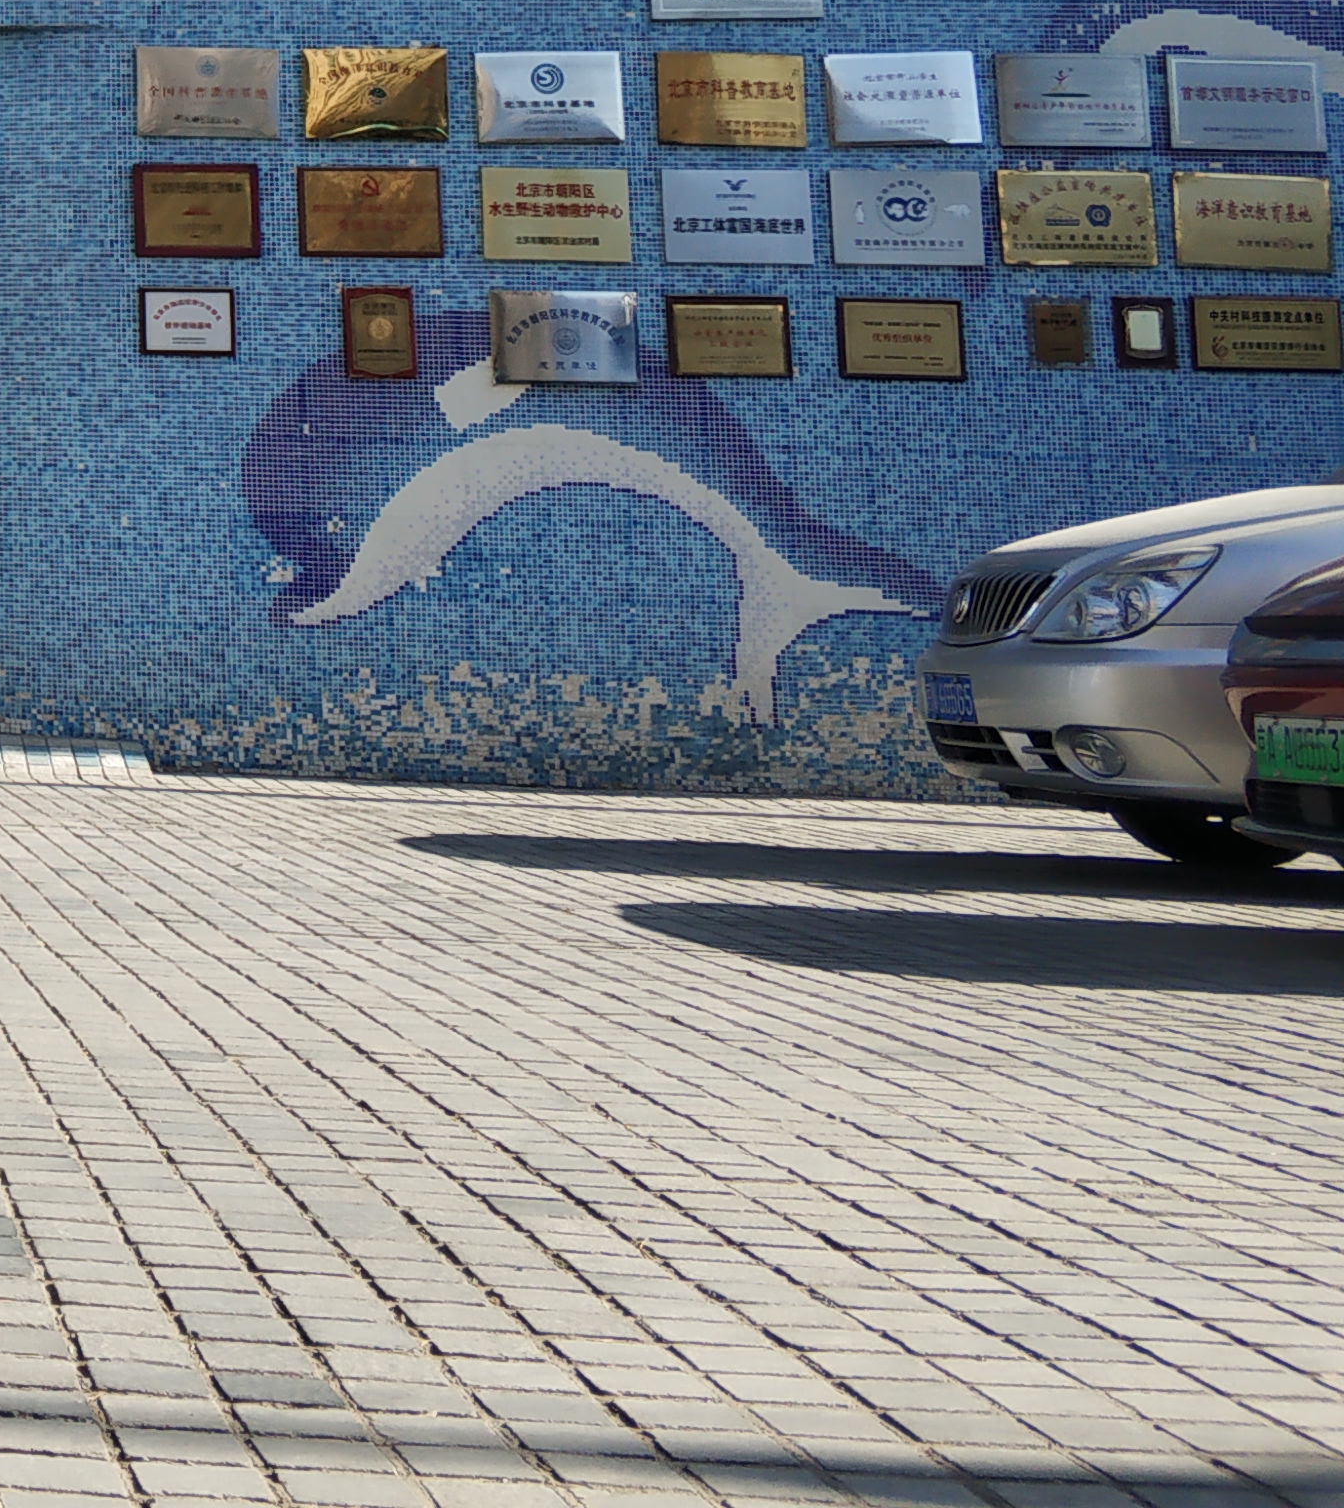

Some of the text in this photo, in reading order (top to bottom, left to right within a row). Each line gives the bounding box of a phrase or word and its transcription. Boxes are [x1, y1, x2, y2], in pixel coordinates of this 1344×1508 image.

[668, 78, 796, 101] 北京市科普教育基地
[516, 182, 596, 198] 北京市朝阳区
[489, 201, 624, 219] 水生野生动物救护中心
[1196, 199, 1313, 223] 海洋意识教育基地
[673, 217, 806, 235] 北京工体富国海底世界
